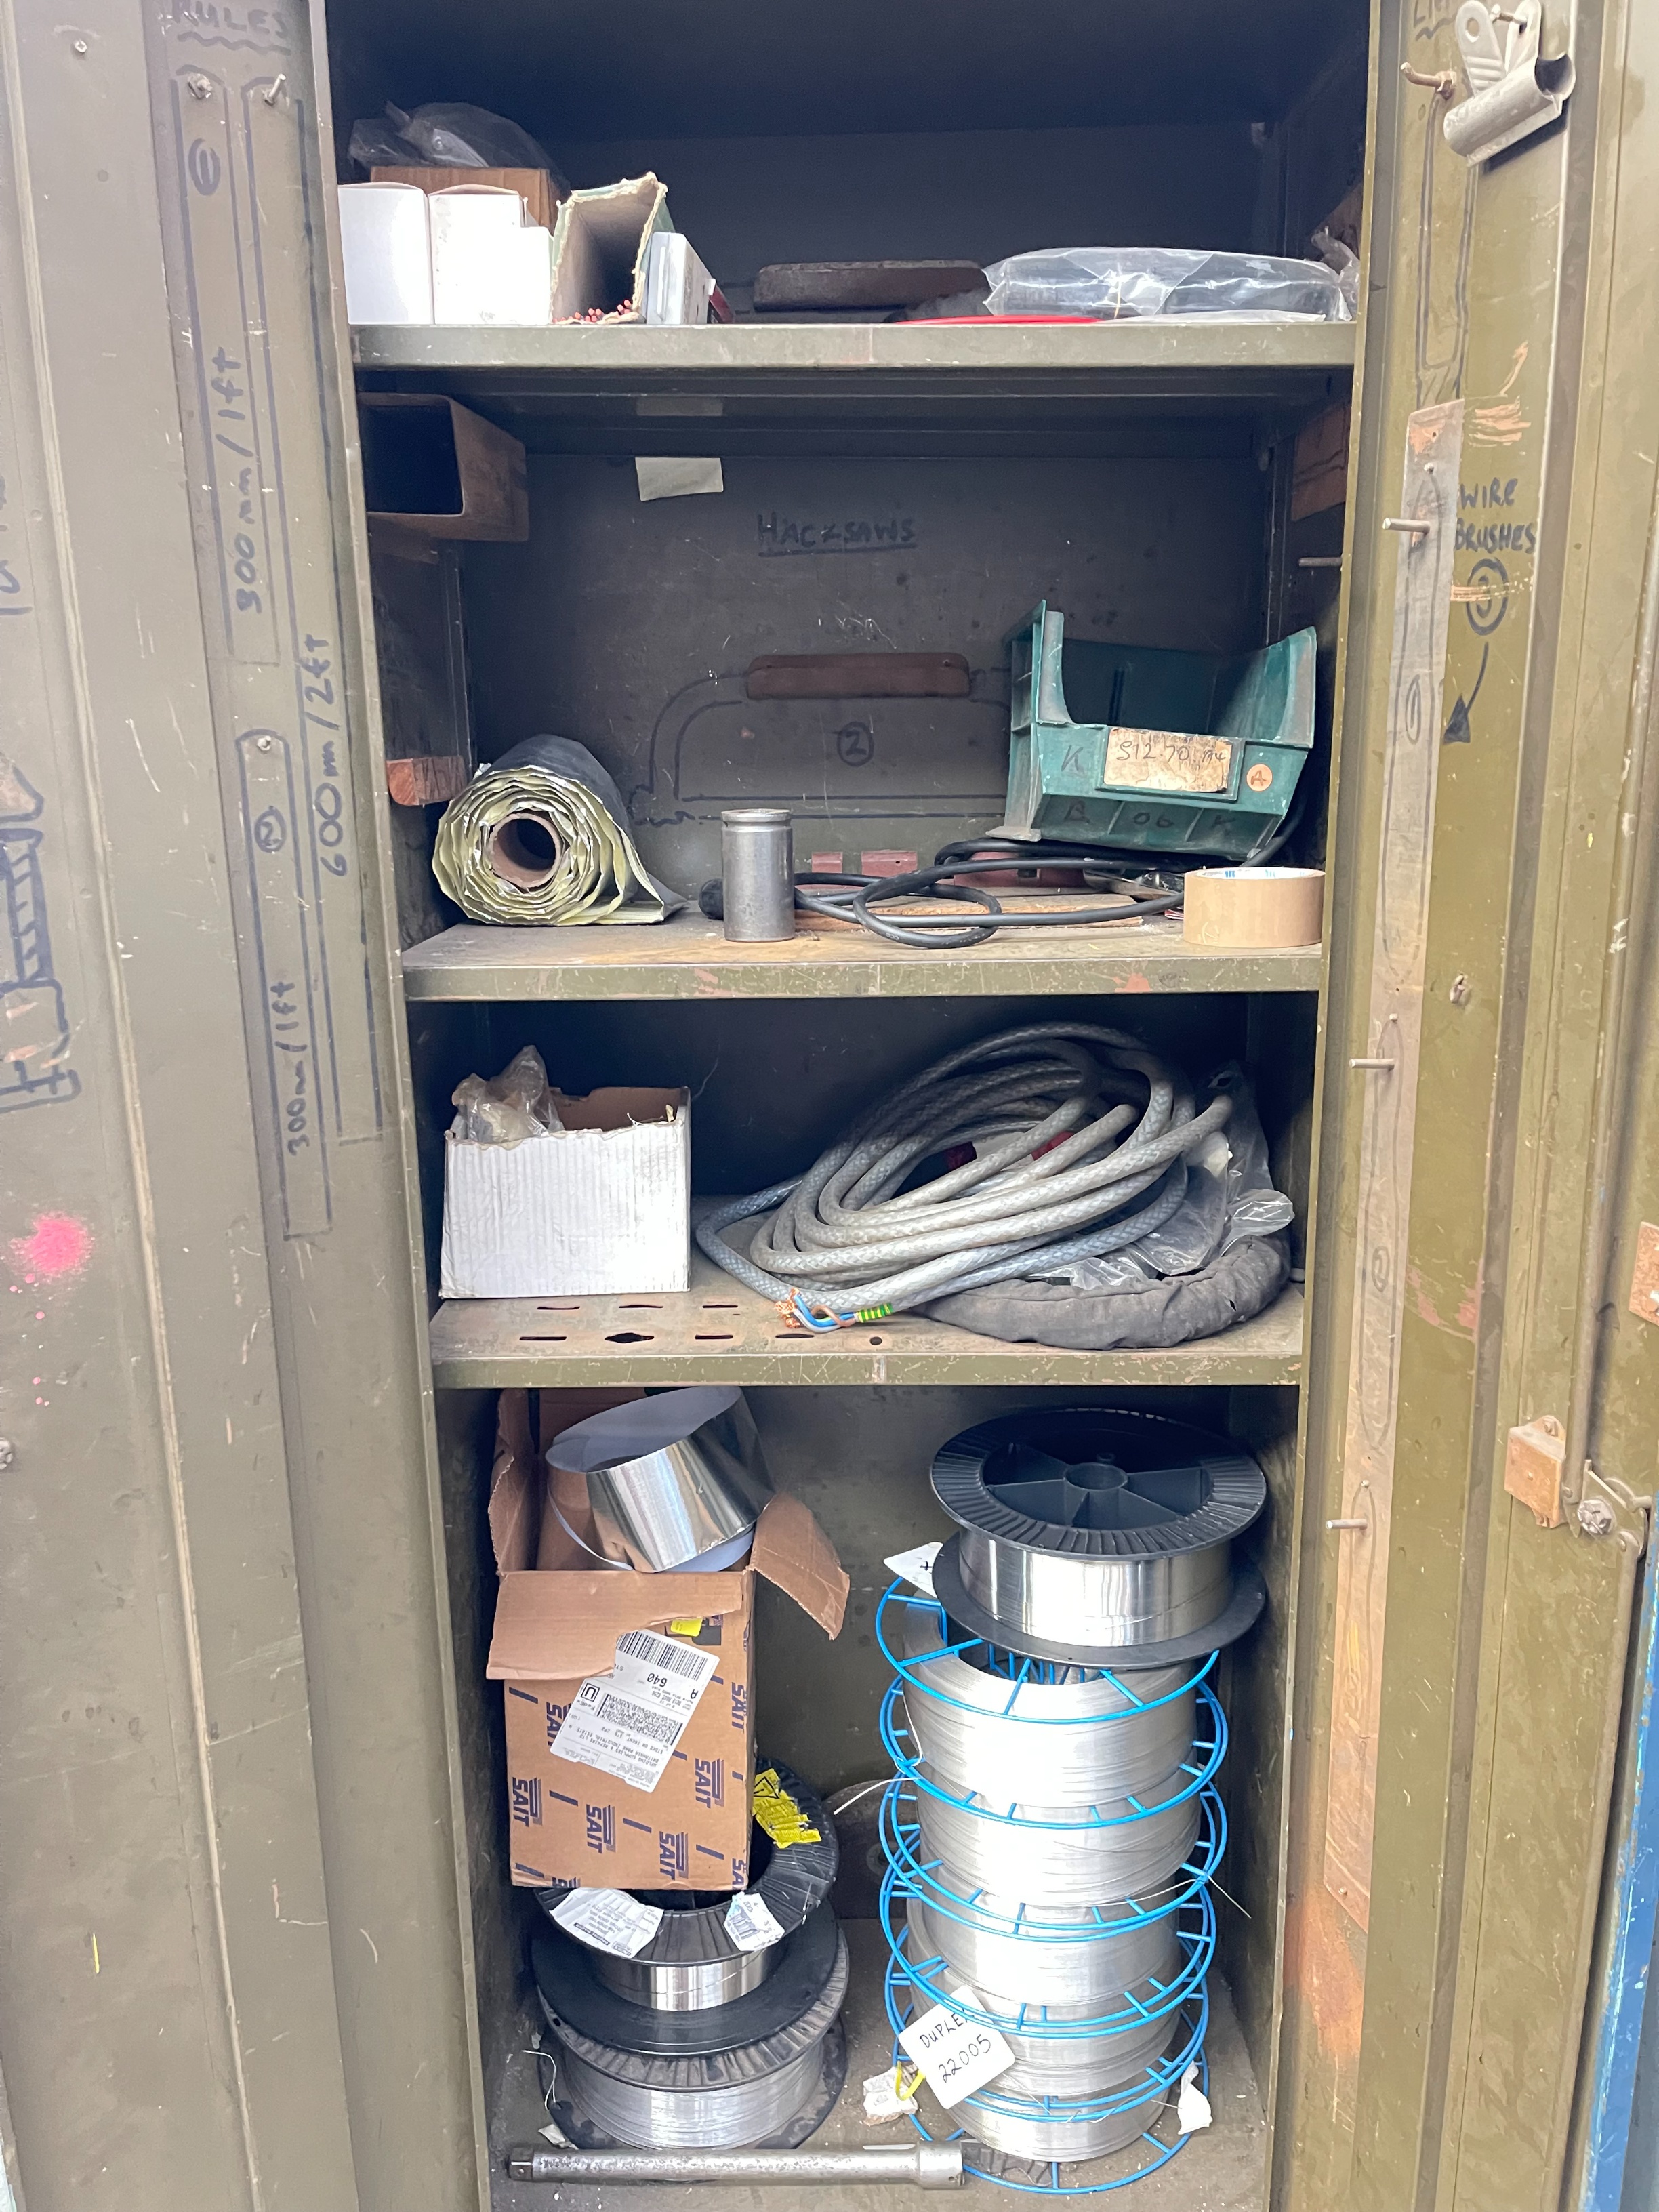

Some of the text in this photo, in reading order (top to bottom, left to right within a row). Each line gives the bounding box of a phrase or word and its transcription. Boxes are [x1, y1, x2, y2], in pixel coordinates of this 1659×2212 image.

[584, 1687, 596, 1699] U
[647, 1672, 668, 1687] 640
[690, 1689, 699, 1700] A
[512, 1777, 530, 1827] SAIT
[695, 1758, 711, 1808] SAIT
[586, 1804, 603, 1854] SAIT
[659, 1831, 676, 1880] SAIT
[938, 2034, 991, 2083] 22005
